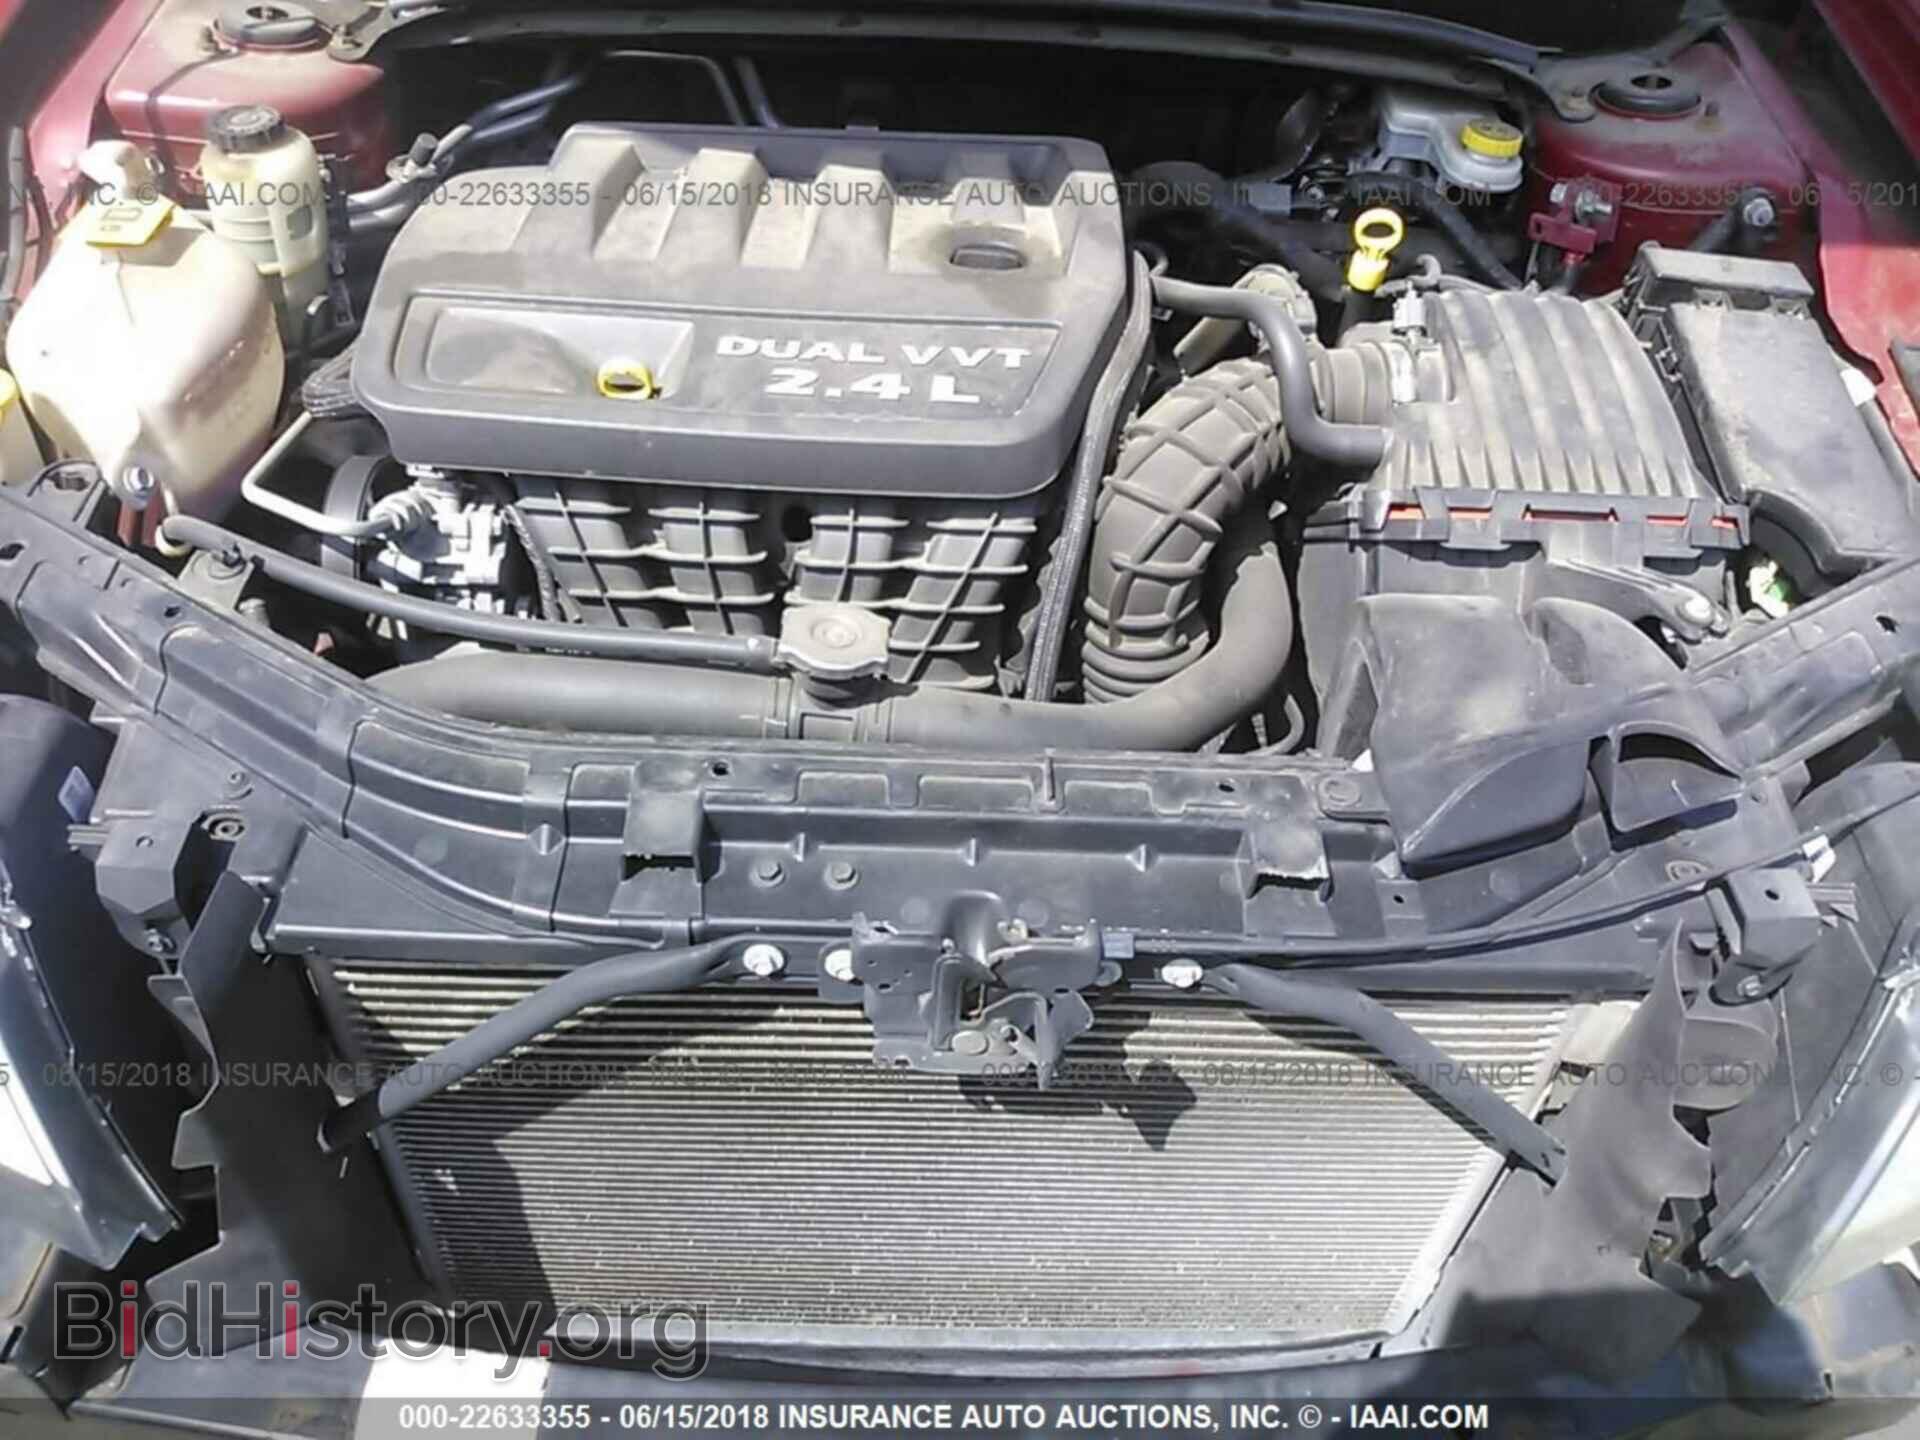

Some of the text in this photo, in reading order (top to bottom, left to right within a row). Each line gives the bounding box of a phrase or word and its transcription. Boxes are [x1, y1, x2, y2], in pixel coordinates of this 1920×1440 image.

[716, 336, 1032, 369] DUAL VVT
[764, 367, 981, 404] 2.4 L
